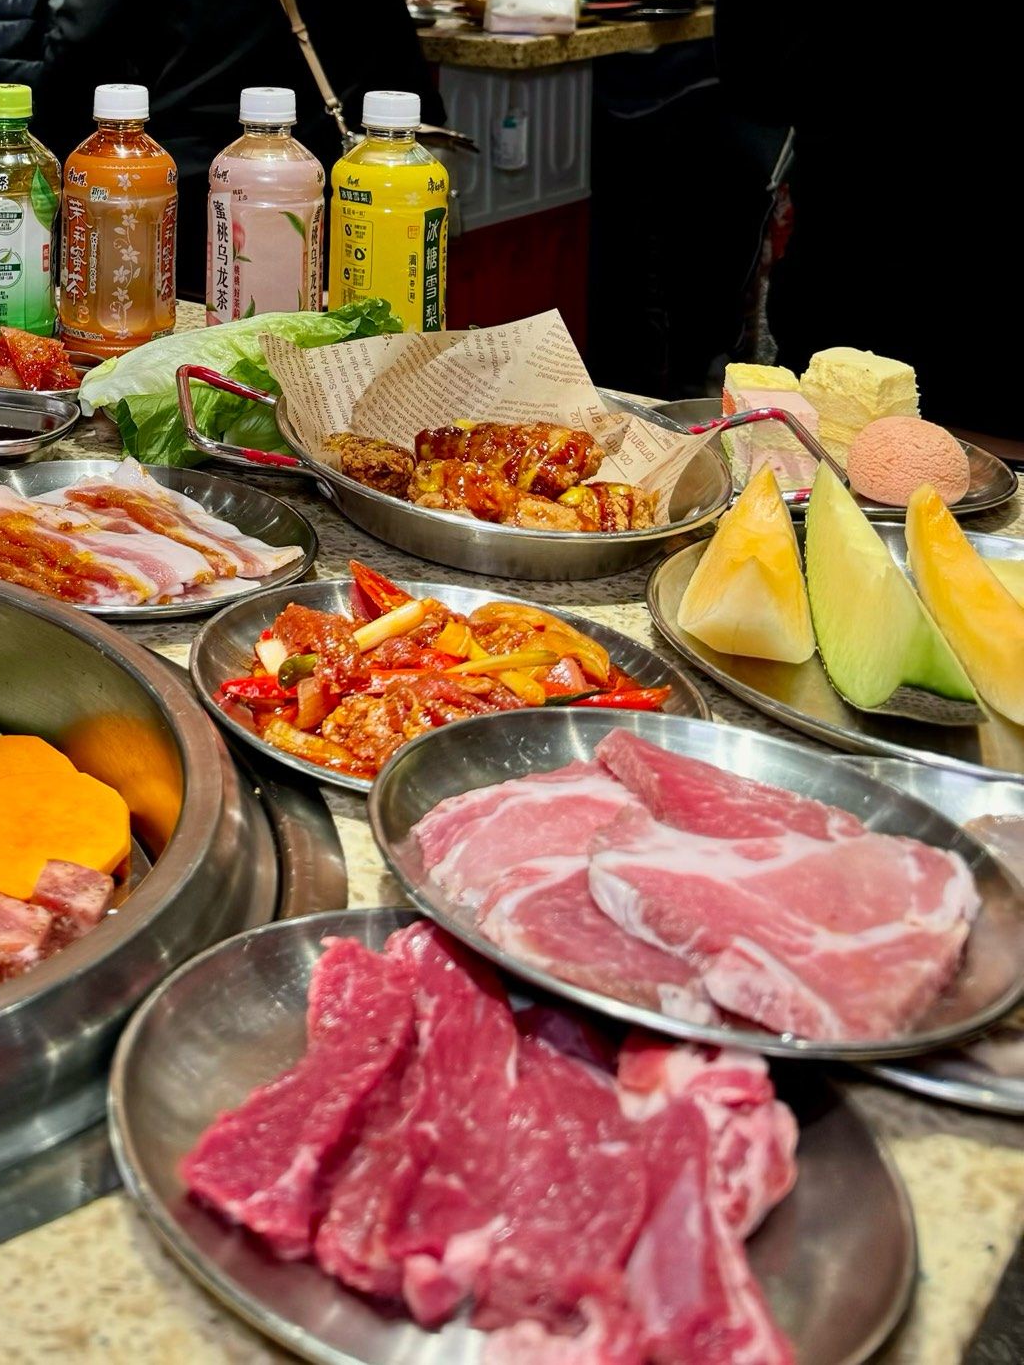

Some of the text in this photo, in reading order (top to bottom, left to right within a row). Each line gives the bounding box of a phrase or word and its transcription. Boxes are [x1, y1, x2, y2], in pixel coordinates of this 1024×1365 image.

[212, 199, 229, 311] 蜜桃乌龙茶
[426, 219, 440, 329] 冰糖雪梨
[601, 433, 634, 466] country
[621, 424, 657, 463] romantic
